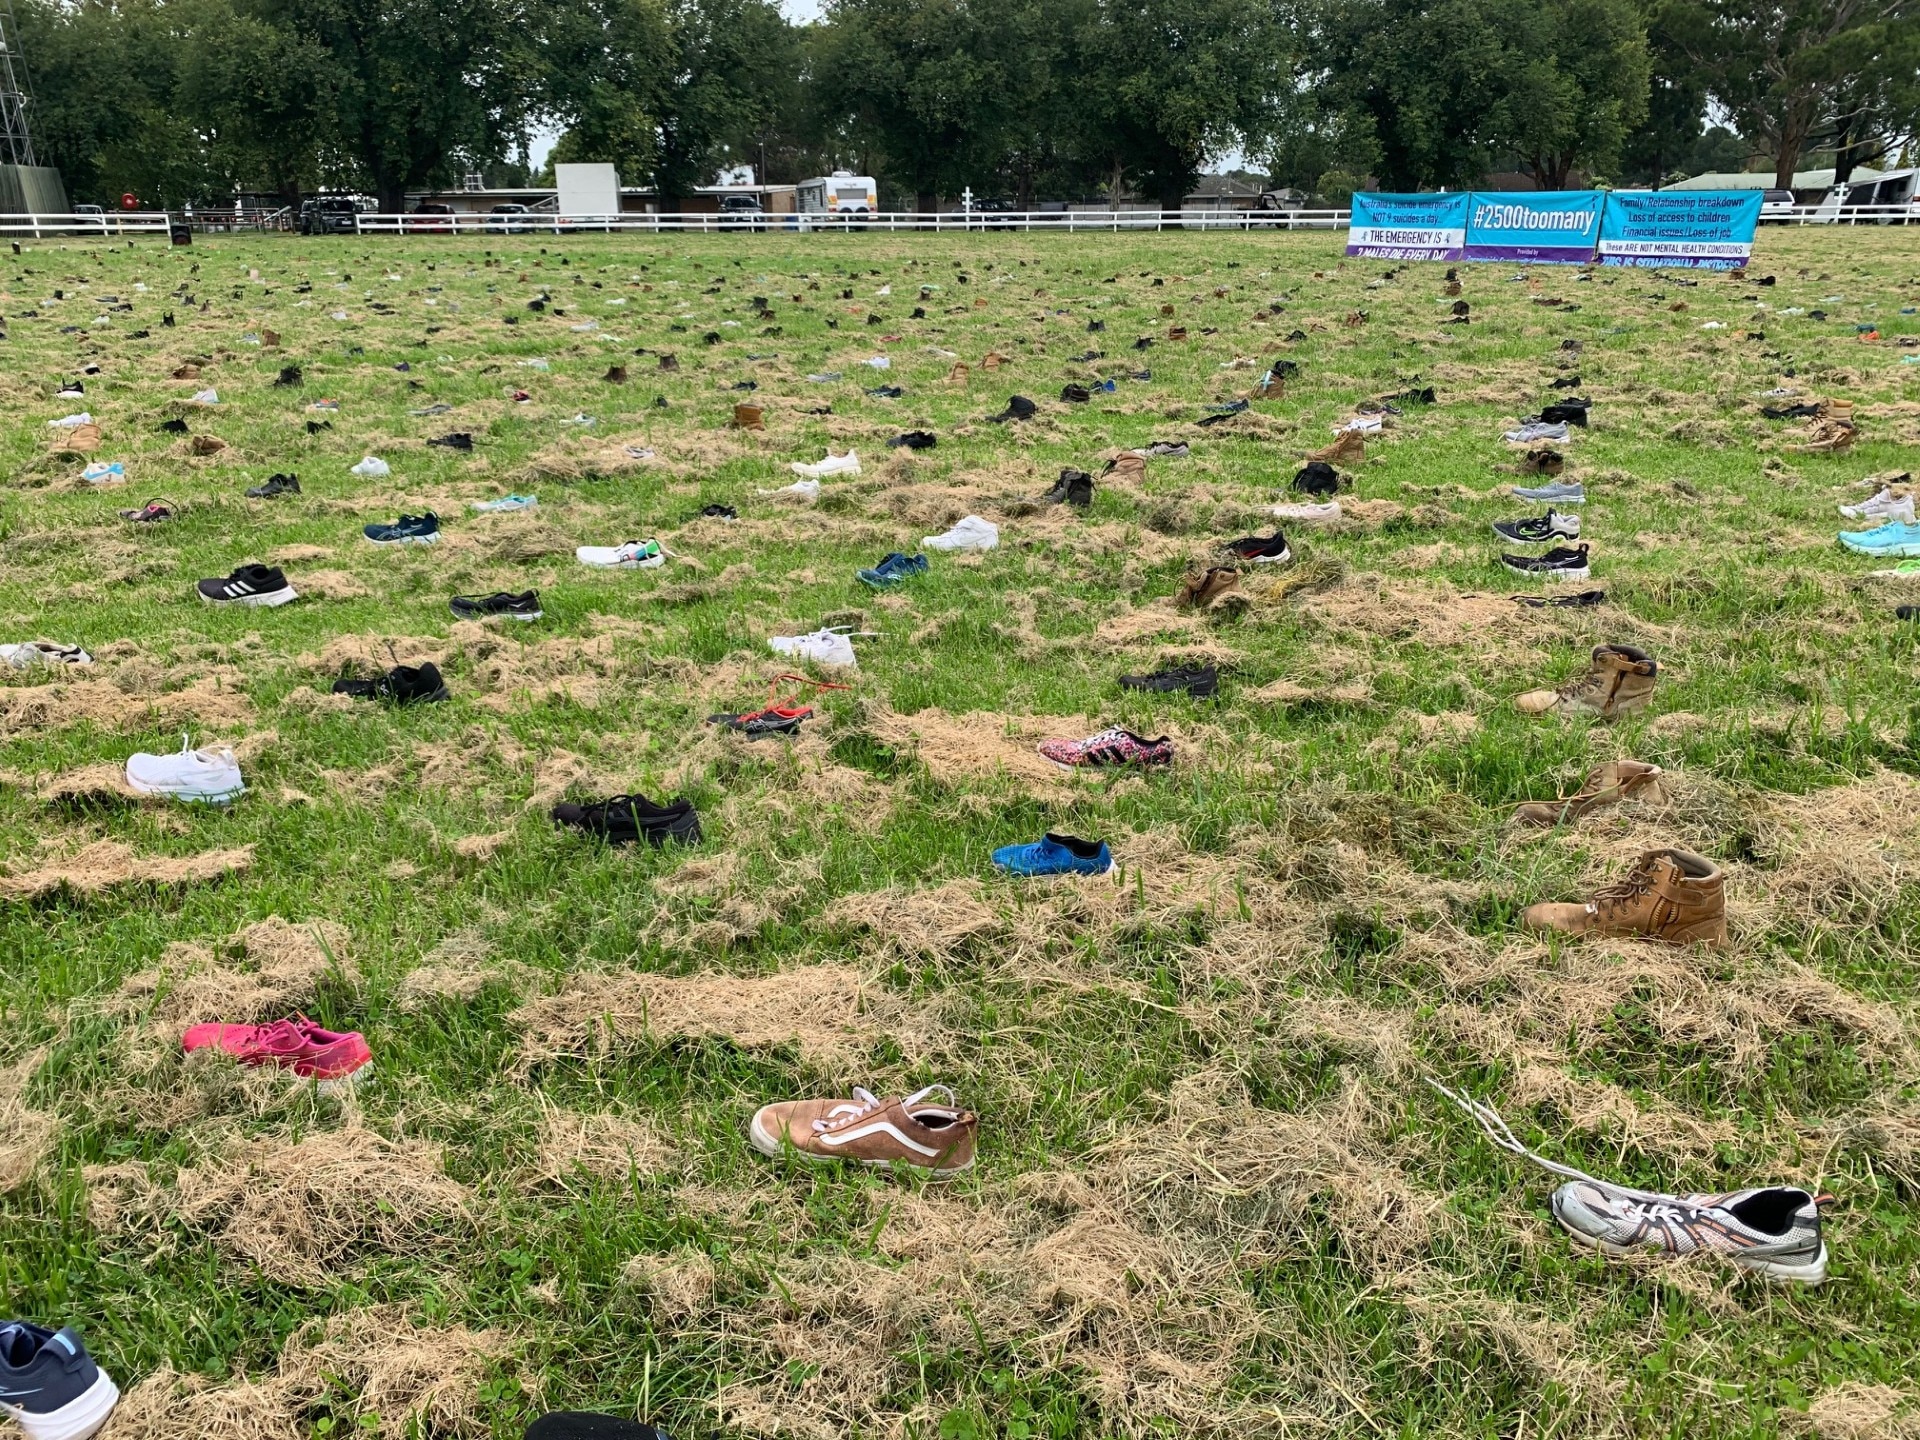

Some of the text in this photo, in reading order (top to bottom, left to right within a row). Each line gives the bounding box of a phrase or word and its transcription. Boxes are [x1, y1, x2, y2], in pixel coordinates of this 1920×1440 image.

[1419, 200, 1453, 211] emergency
[1698, 197, 1745, 208] breakdown
[1373, 213, 1386, 222] NOT
[1393, 212, 1419, 223] suicides
[1420, 215, 1426, 223] a
[1473, 205, 1596, 236] #2500toomany
[1628, 211, 1731, 222] Loss of access to children
[1370, 230, 1442, 244] THE EMERGENCY IS
[1622, 225, 1657, 237] Financial
[1709, 226, 1718, 237] of
[1718, 226, 1731, 240] job
[1606, 242, 1743, 254] These ARE NOT MENTAL HEALTH CONDITIONS
